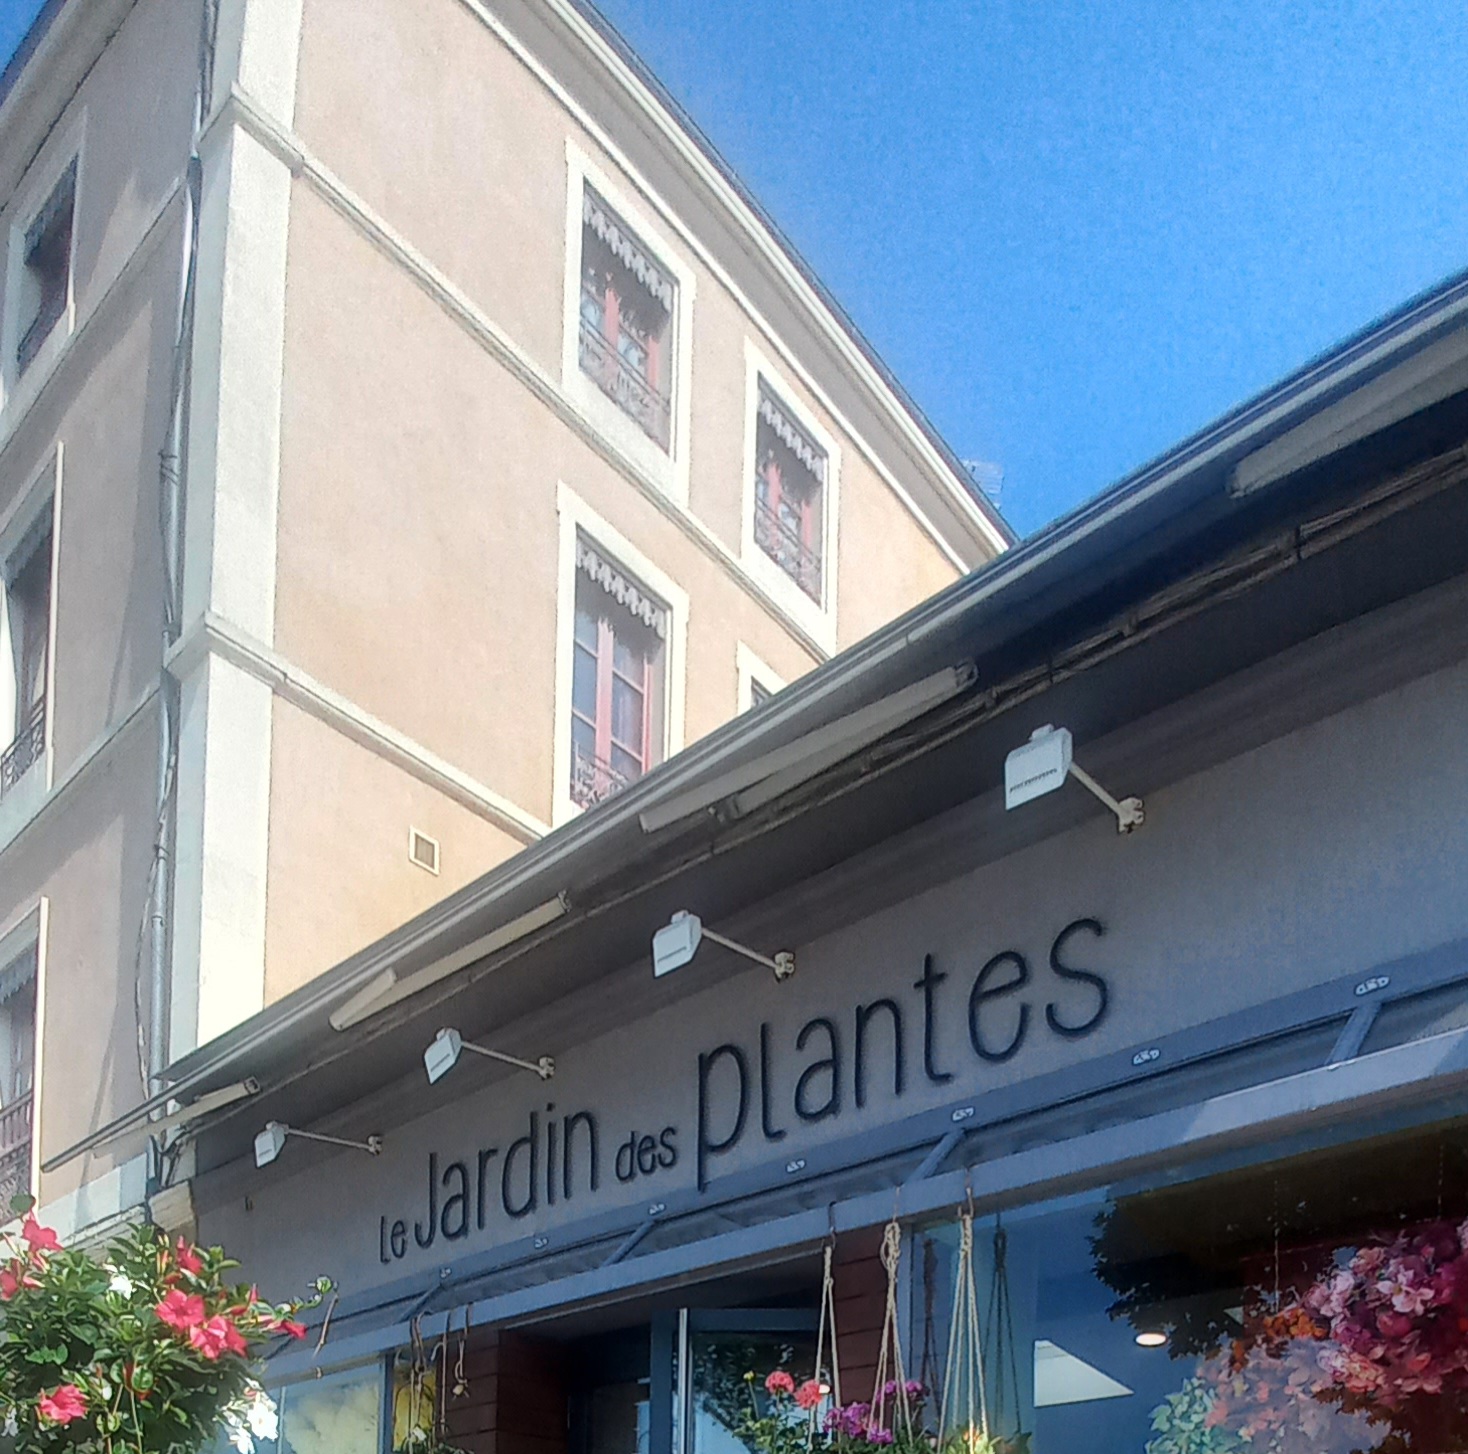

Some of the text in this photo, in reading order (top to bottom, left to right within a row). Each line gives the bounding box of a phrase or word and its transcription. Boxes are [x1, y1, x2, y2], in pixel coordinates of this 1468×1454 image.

[380, 917, 1108, 1264] le Jardin des plantes
